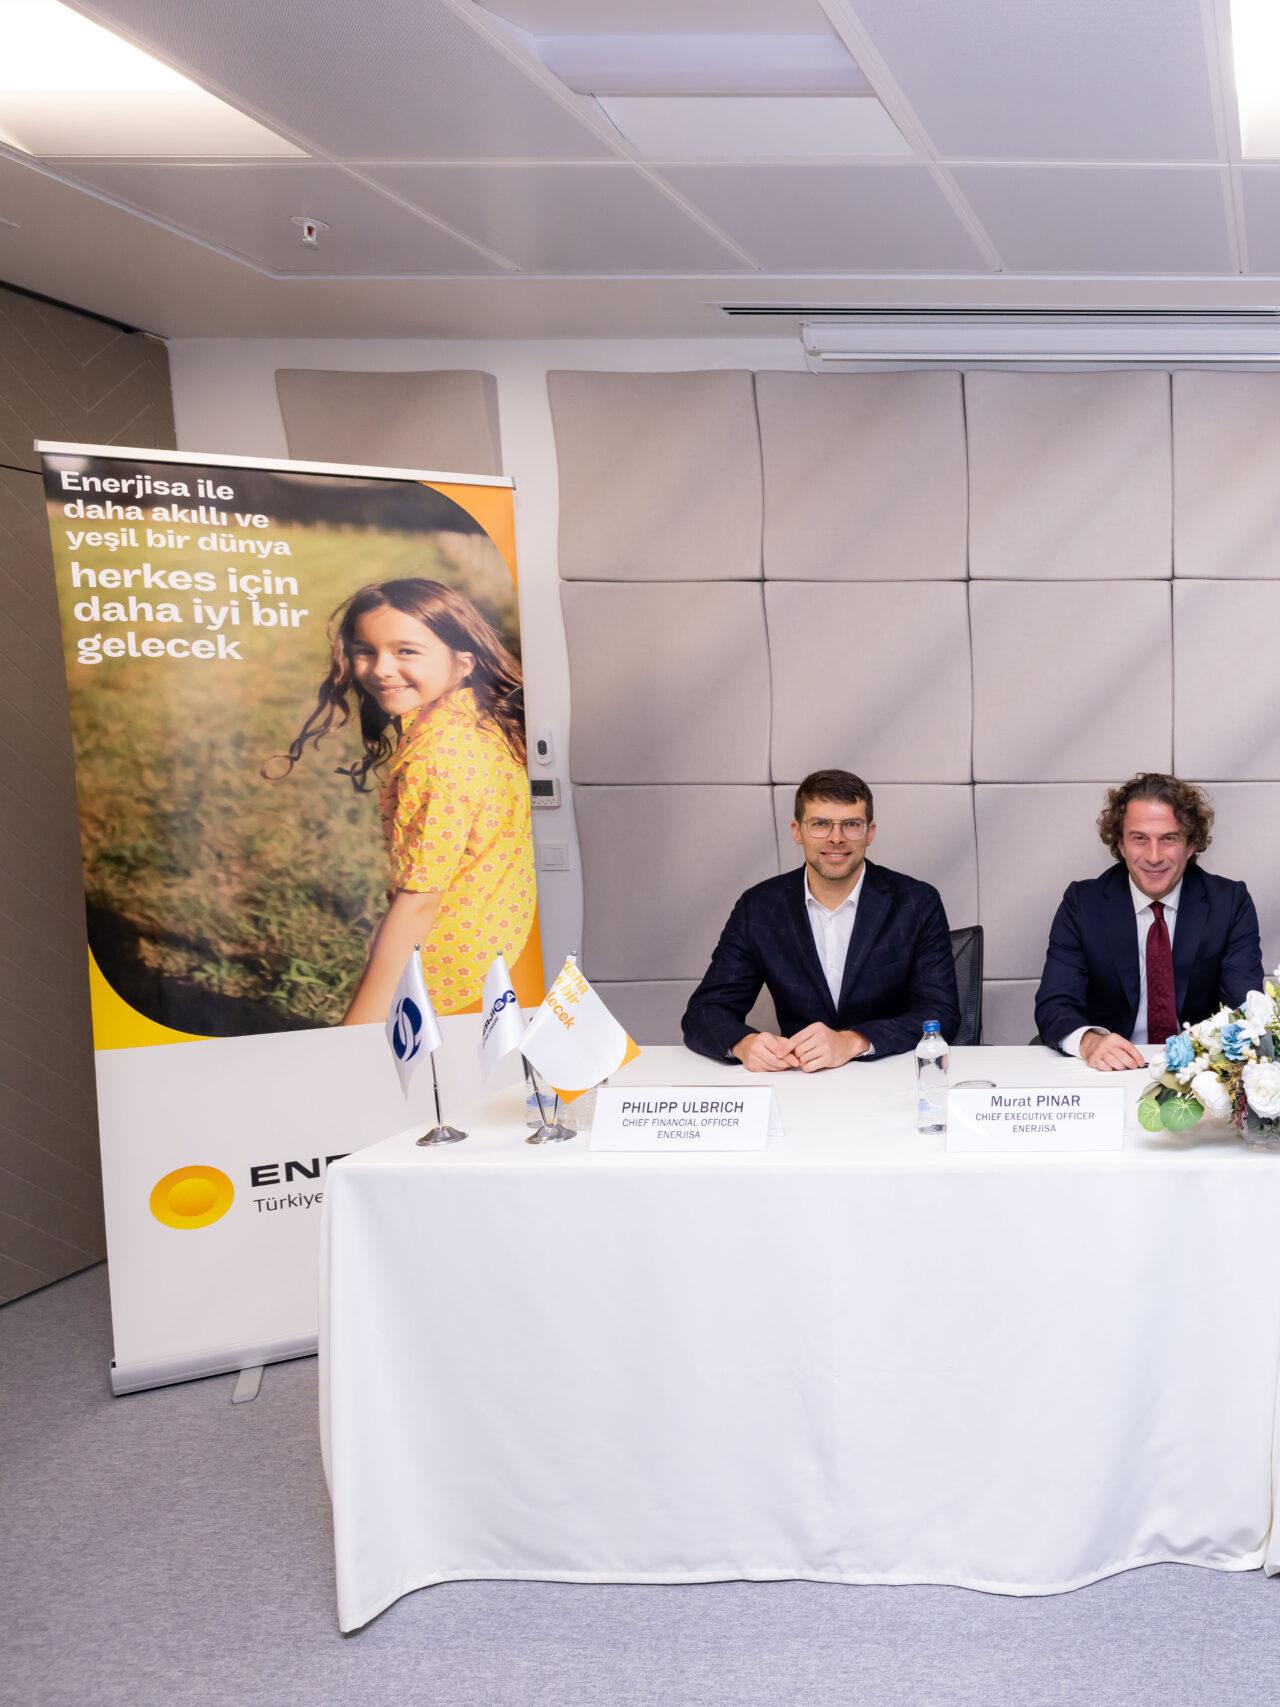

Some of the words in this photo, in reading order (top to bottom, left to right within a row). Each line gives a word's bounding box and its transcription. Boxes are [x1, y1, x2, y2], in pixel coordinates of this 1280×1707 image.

[60, 470, 190, 499] Enerjisa
[197, 479, 234, 500] ile
[63, 499, 144, 521] daha
[152, 504, 228, 526] akıllı
[234, 513, 269, 528] ve
[65, 528, 139, 551] yeşil
[146, 530, 190, 549] bir
[197, 536, 292, 557] dünya
[70, 562, 217, 591] herkes
[228, 567, 299, 600] için
[73, 596, 182, 623] daha
[194, 599, 240, 630] iyi
[251, 601, 309, 628] bir
[76, 633, 243, 665] gelecek
[545, 991, 575, 1031] lecek
[621, 1101, 678, 1113] PHILIPP
[682, 1101, 744, 1113] ULBRICH
[991, 1095, 1032, 1107] Murat
[1036, 1095, 1081, 1107] PINAR
[622, 1118, 649, 1127] CHIEF
[651, 1118, 698, 1127] FINANCIAL
[701, 1118, 740, 1127] OFFICER
[975, 1112, 1002, 1121] CHIEF
[1004, 1112, 1054, 1121] EXECUTIVE
[1056, 1112, 1095, 1121] OFFICER
[1012, 1124, 1056, 1133] ENERJISA
[657, 1130, 701, 1139] ENERJISA
